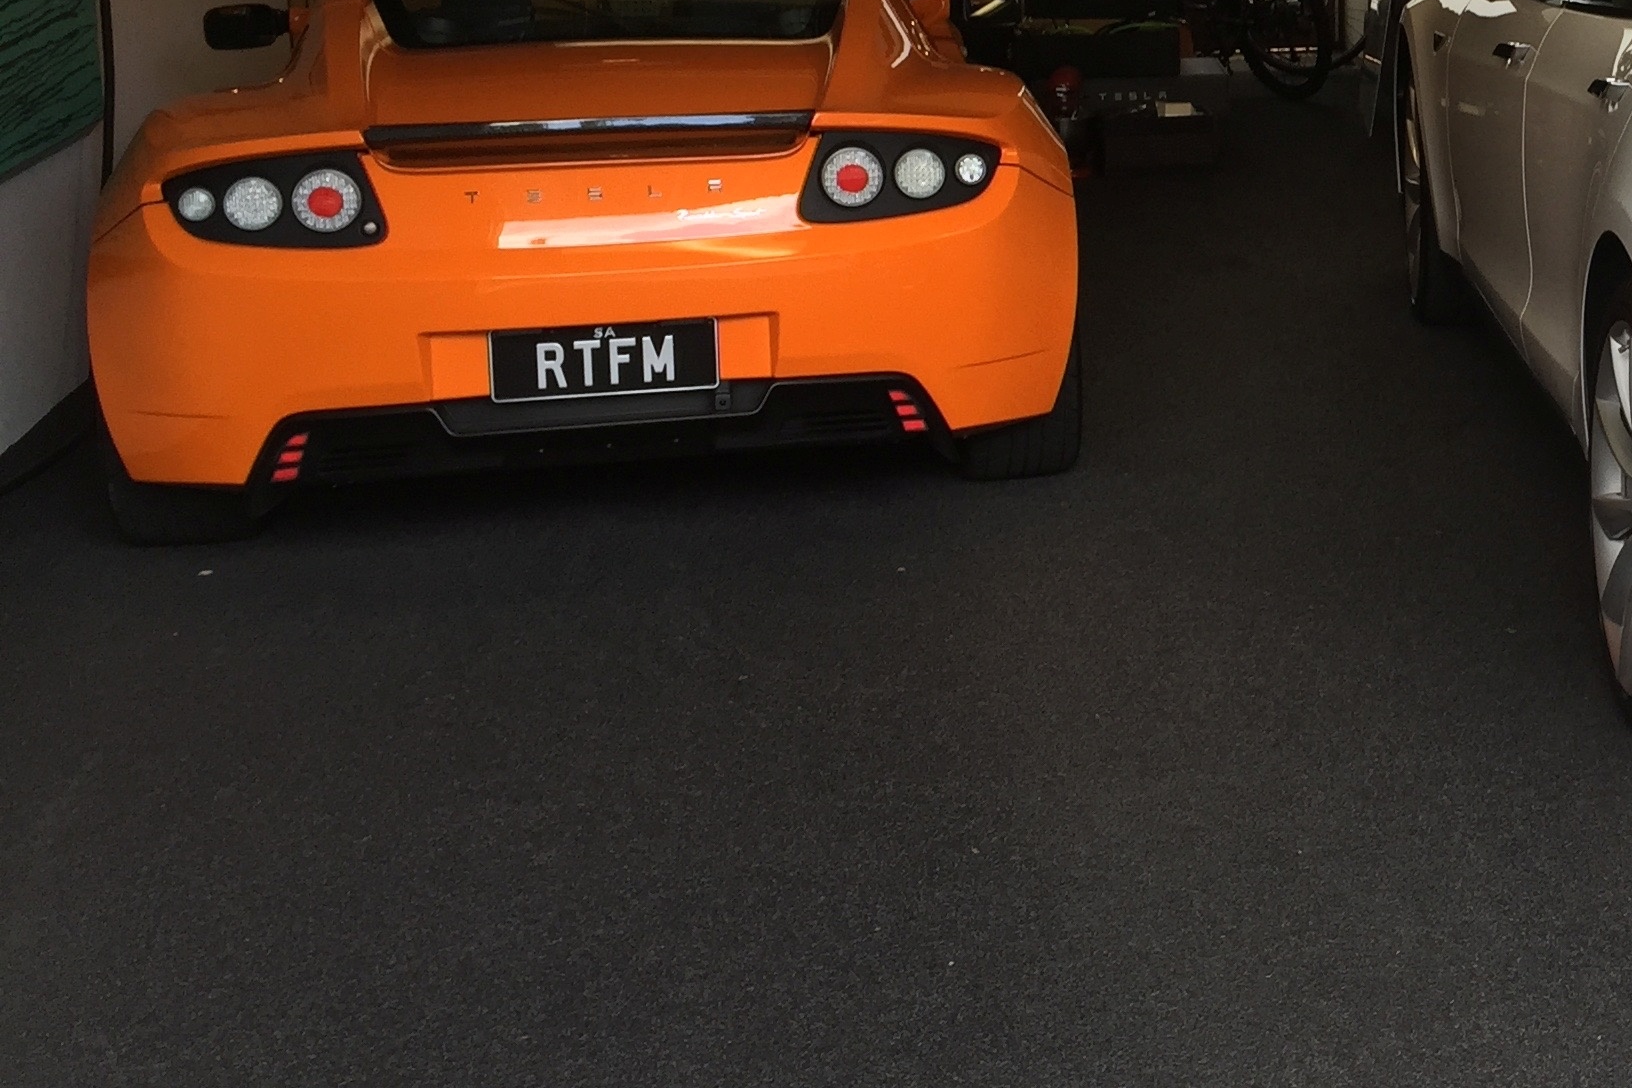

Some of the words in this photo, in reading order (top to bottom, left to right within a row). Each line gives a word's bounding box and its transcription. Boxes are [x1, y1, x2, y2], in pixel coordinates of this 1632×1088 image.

[463, 178, 723, 204] TESLA
[593, 326, 617, 339] SA
[536, 334, 676, 390] RTFM
